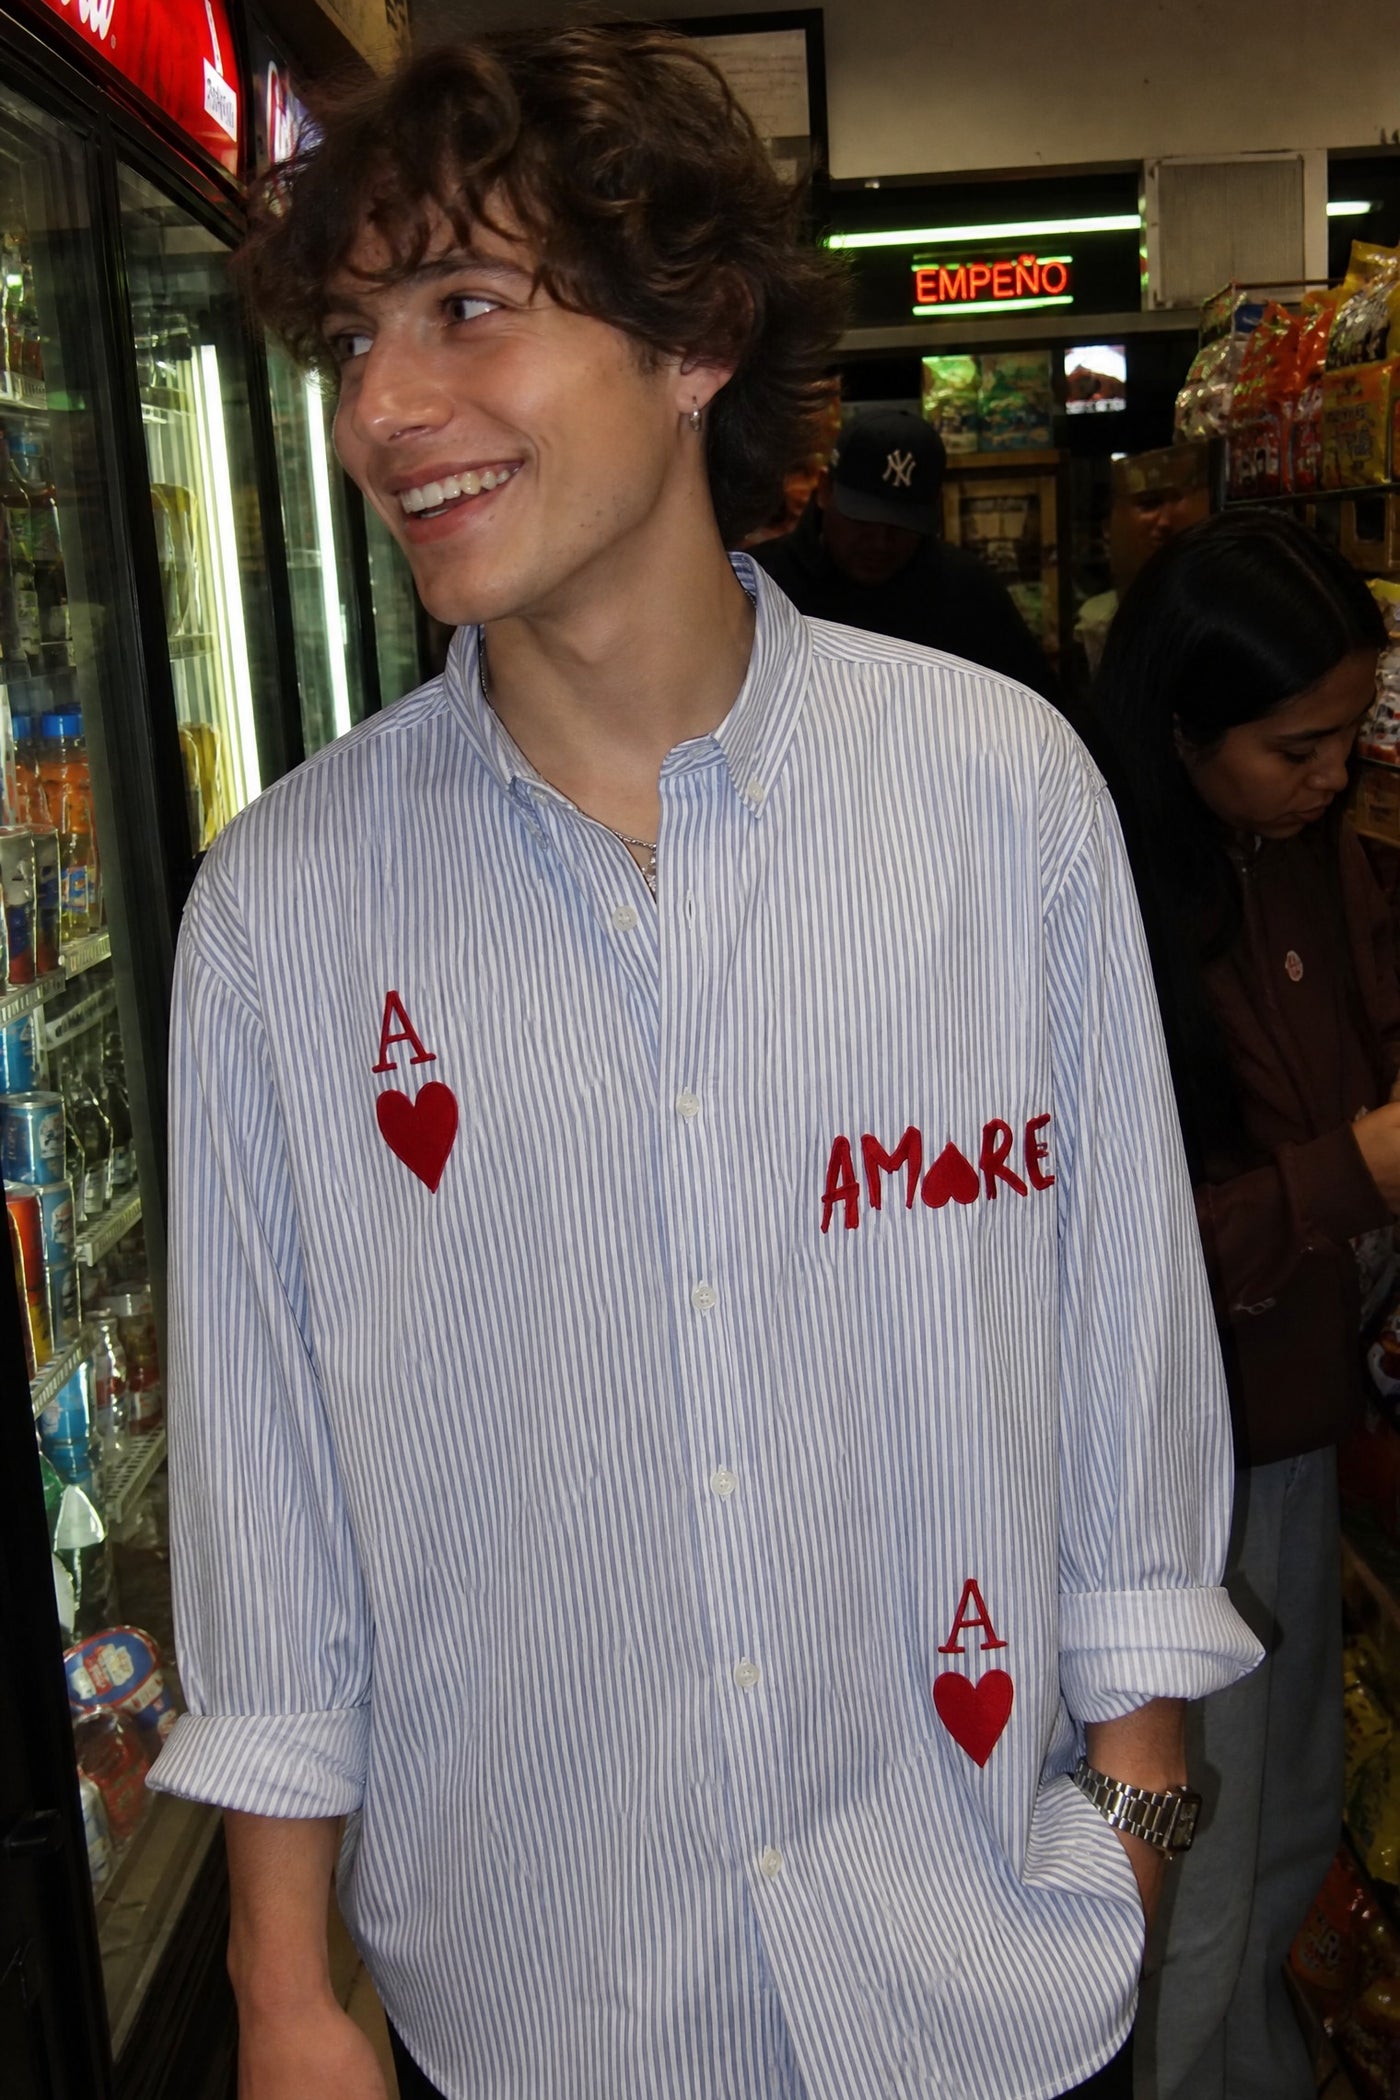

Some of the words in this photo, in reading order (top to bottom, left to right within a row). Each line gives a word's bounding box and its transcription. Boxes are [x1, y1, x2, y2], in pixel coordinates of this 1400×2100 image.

[916, 254, 1068, 303] EMPEÑO
[882, 449, 916, 487] NY
[372, 990, 436, 1073] A
[937, 1578, 1008, 1653] A
